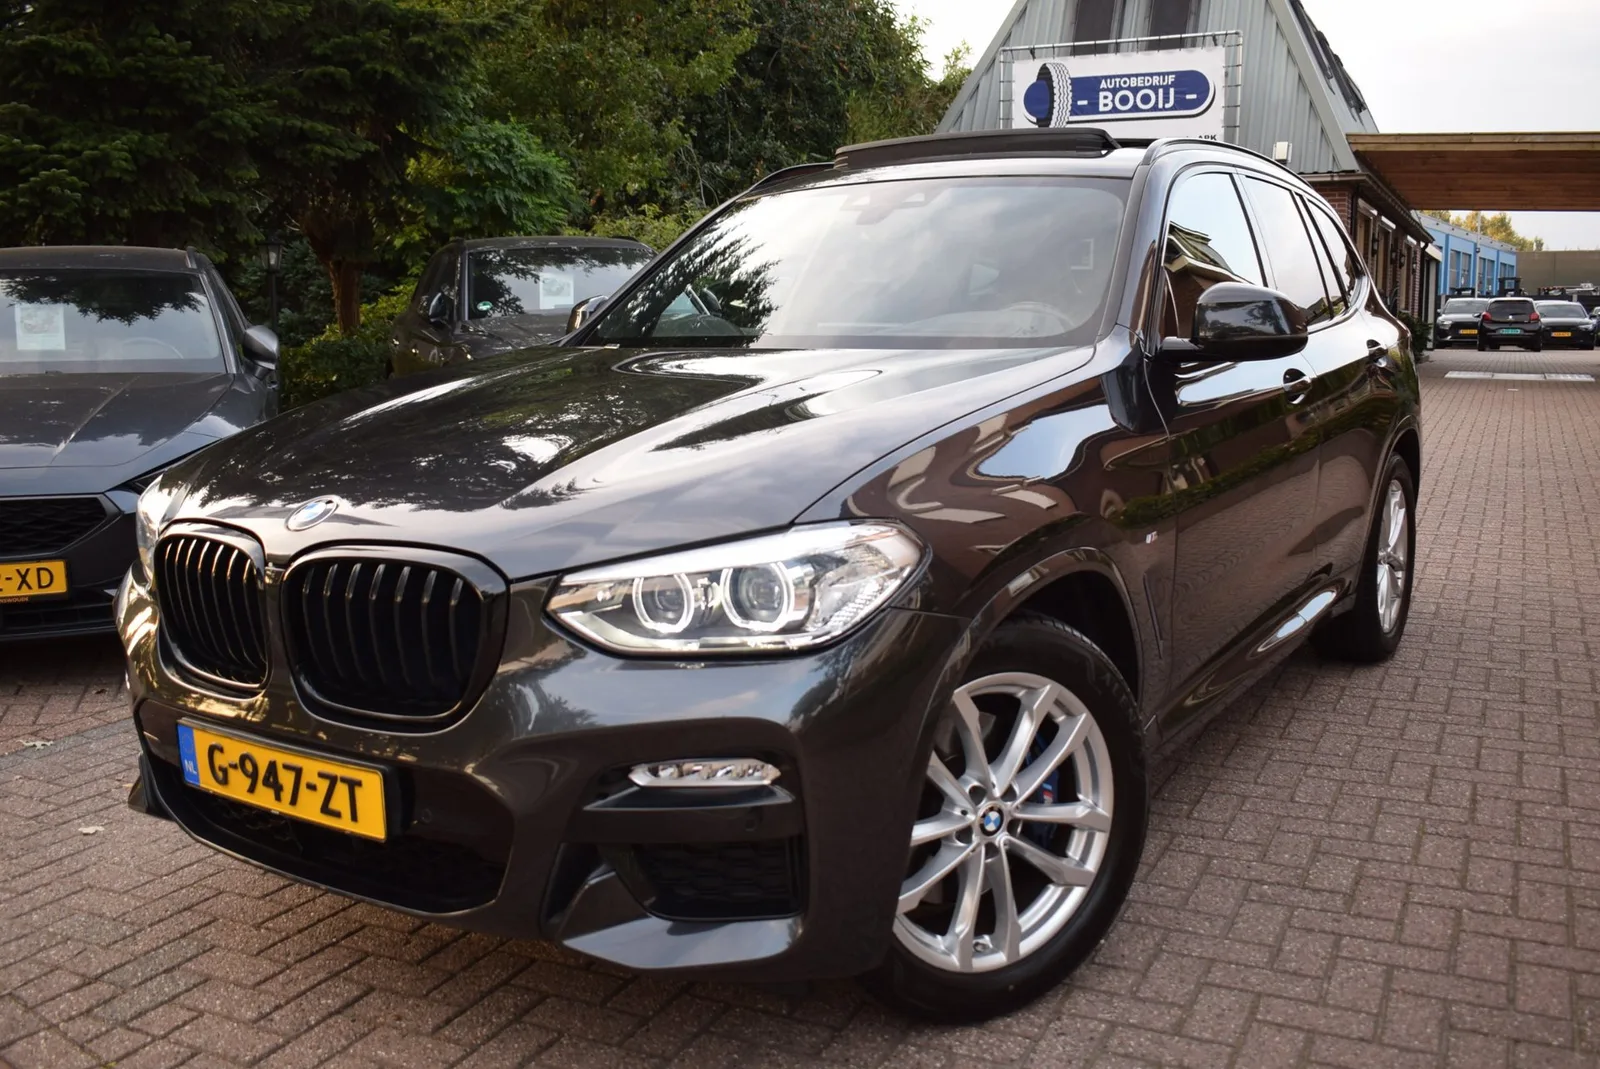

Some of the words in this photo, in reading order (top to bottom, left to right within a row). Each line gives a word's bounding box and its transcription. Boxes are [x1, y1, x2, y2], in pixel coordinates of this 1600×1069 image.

[1100, 74, 1175, 90] AUTOBEDRIJF
[1099, 88, 1175, 112] BOOIJ
[0, 567, 54, 592] -XD
[184, 759, 198, 775] NL
[207, 742, 363, 823] G-947-ZT
